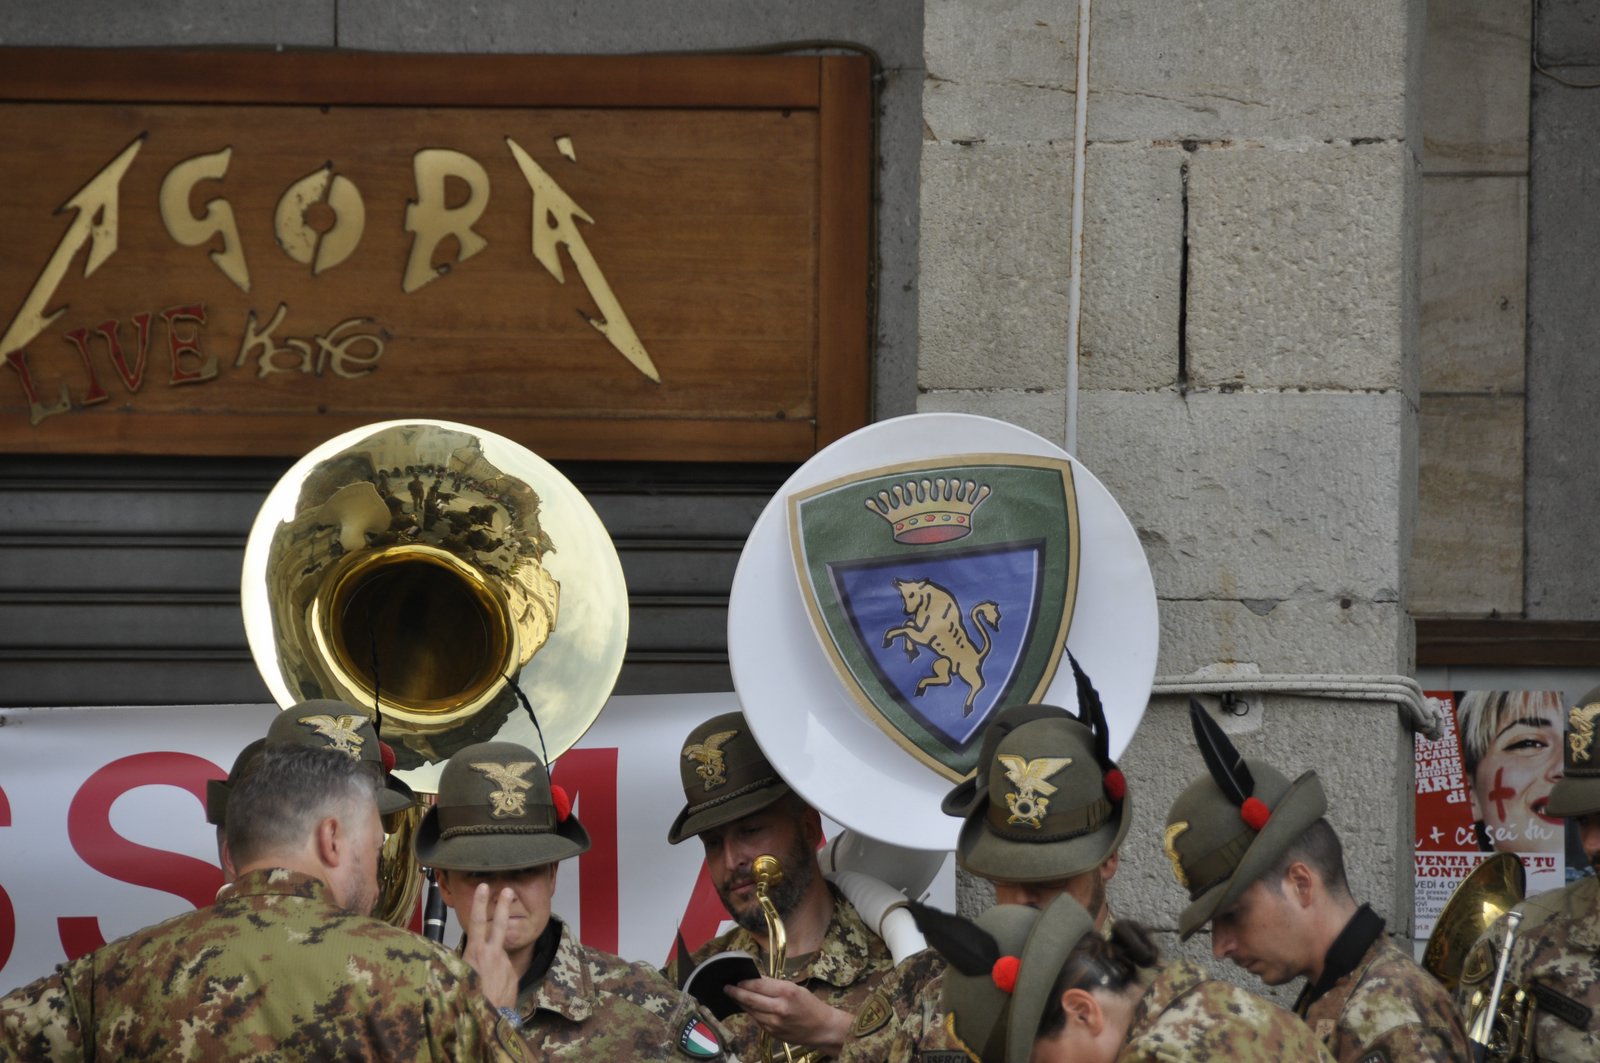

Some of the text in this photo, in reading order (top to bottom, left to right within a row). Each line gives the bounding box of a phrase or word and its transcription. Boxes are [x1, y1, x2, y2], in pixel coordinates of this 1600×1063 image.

[5, 303, 219, 425] LIVE
[1446, 789, 1467, 804] di
[1484, 823, 1519, 845] sei
[1523, 817, 1555, 841] tu
[1533, 857, 1556, 868] TU
[1439, 881, 1445, 889] 4
[681, 1018, 698, 1045] ITALIA
